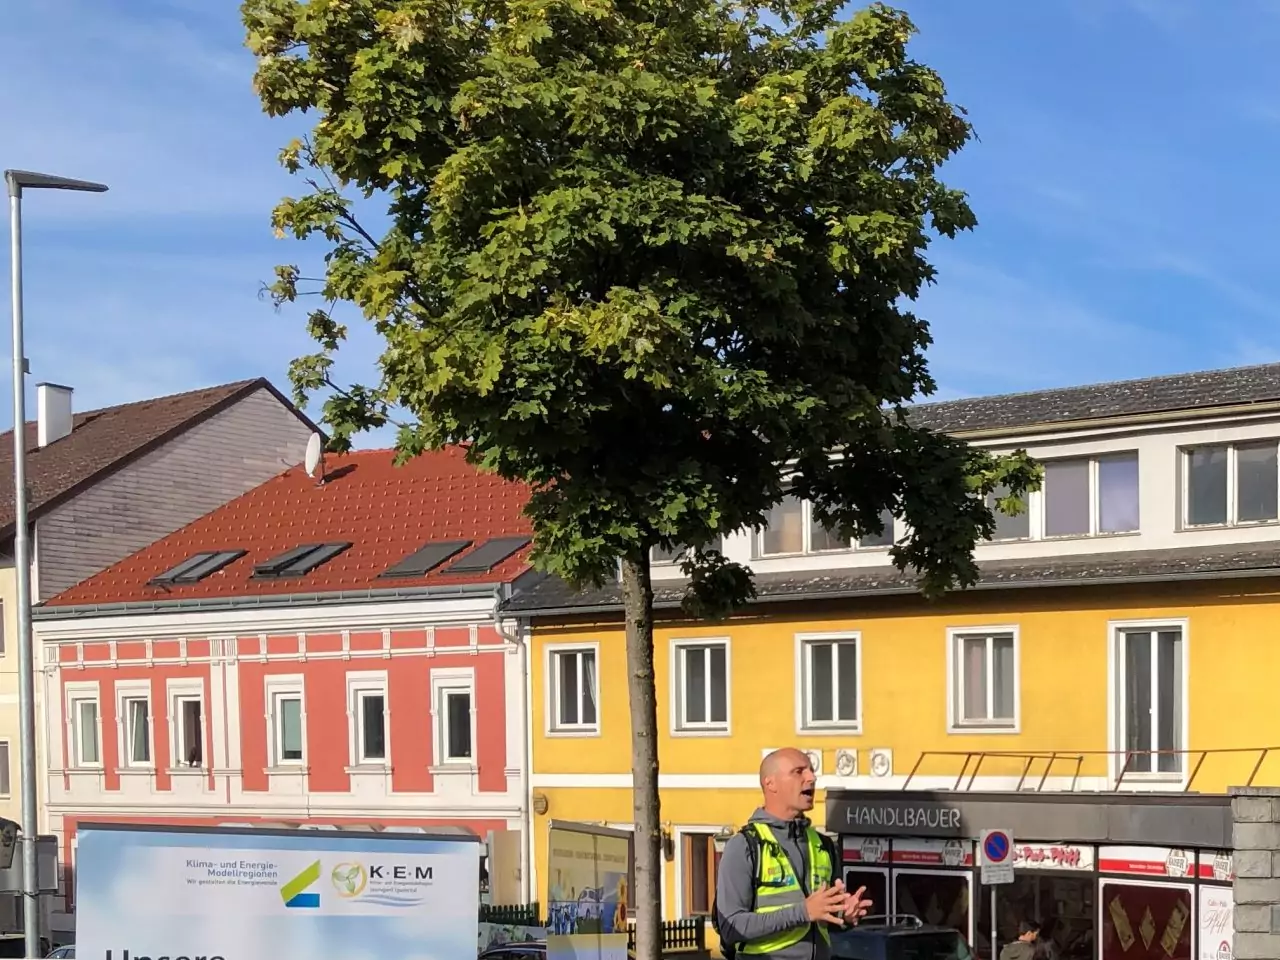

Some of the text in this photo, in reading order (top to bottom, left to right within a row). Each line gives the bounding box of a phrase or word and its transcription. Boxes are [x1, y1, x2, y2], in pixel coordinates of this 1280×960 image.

[846, 806, 961, 828] HANDLBAUER
[186, 859, 278, 871] Klima- und Energie-
[207, 868, 278, 879] Modellregionen
